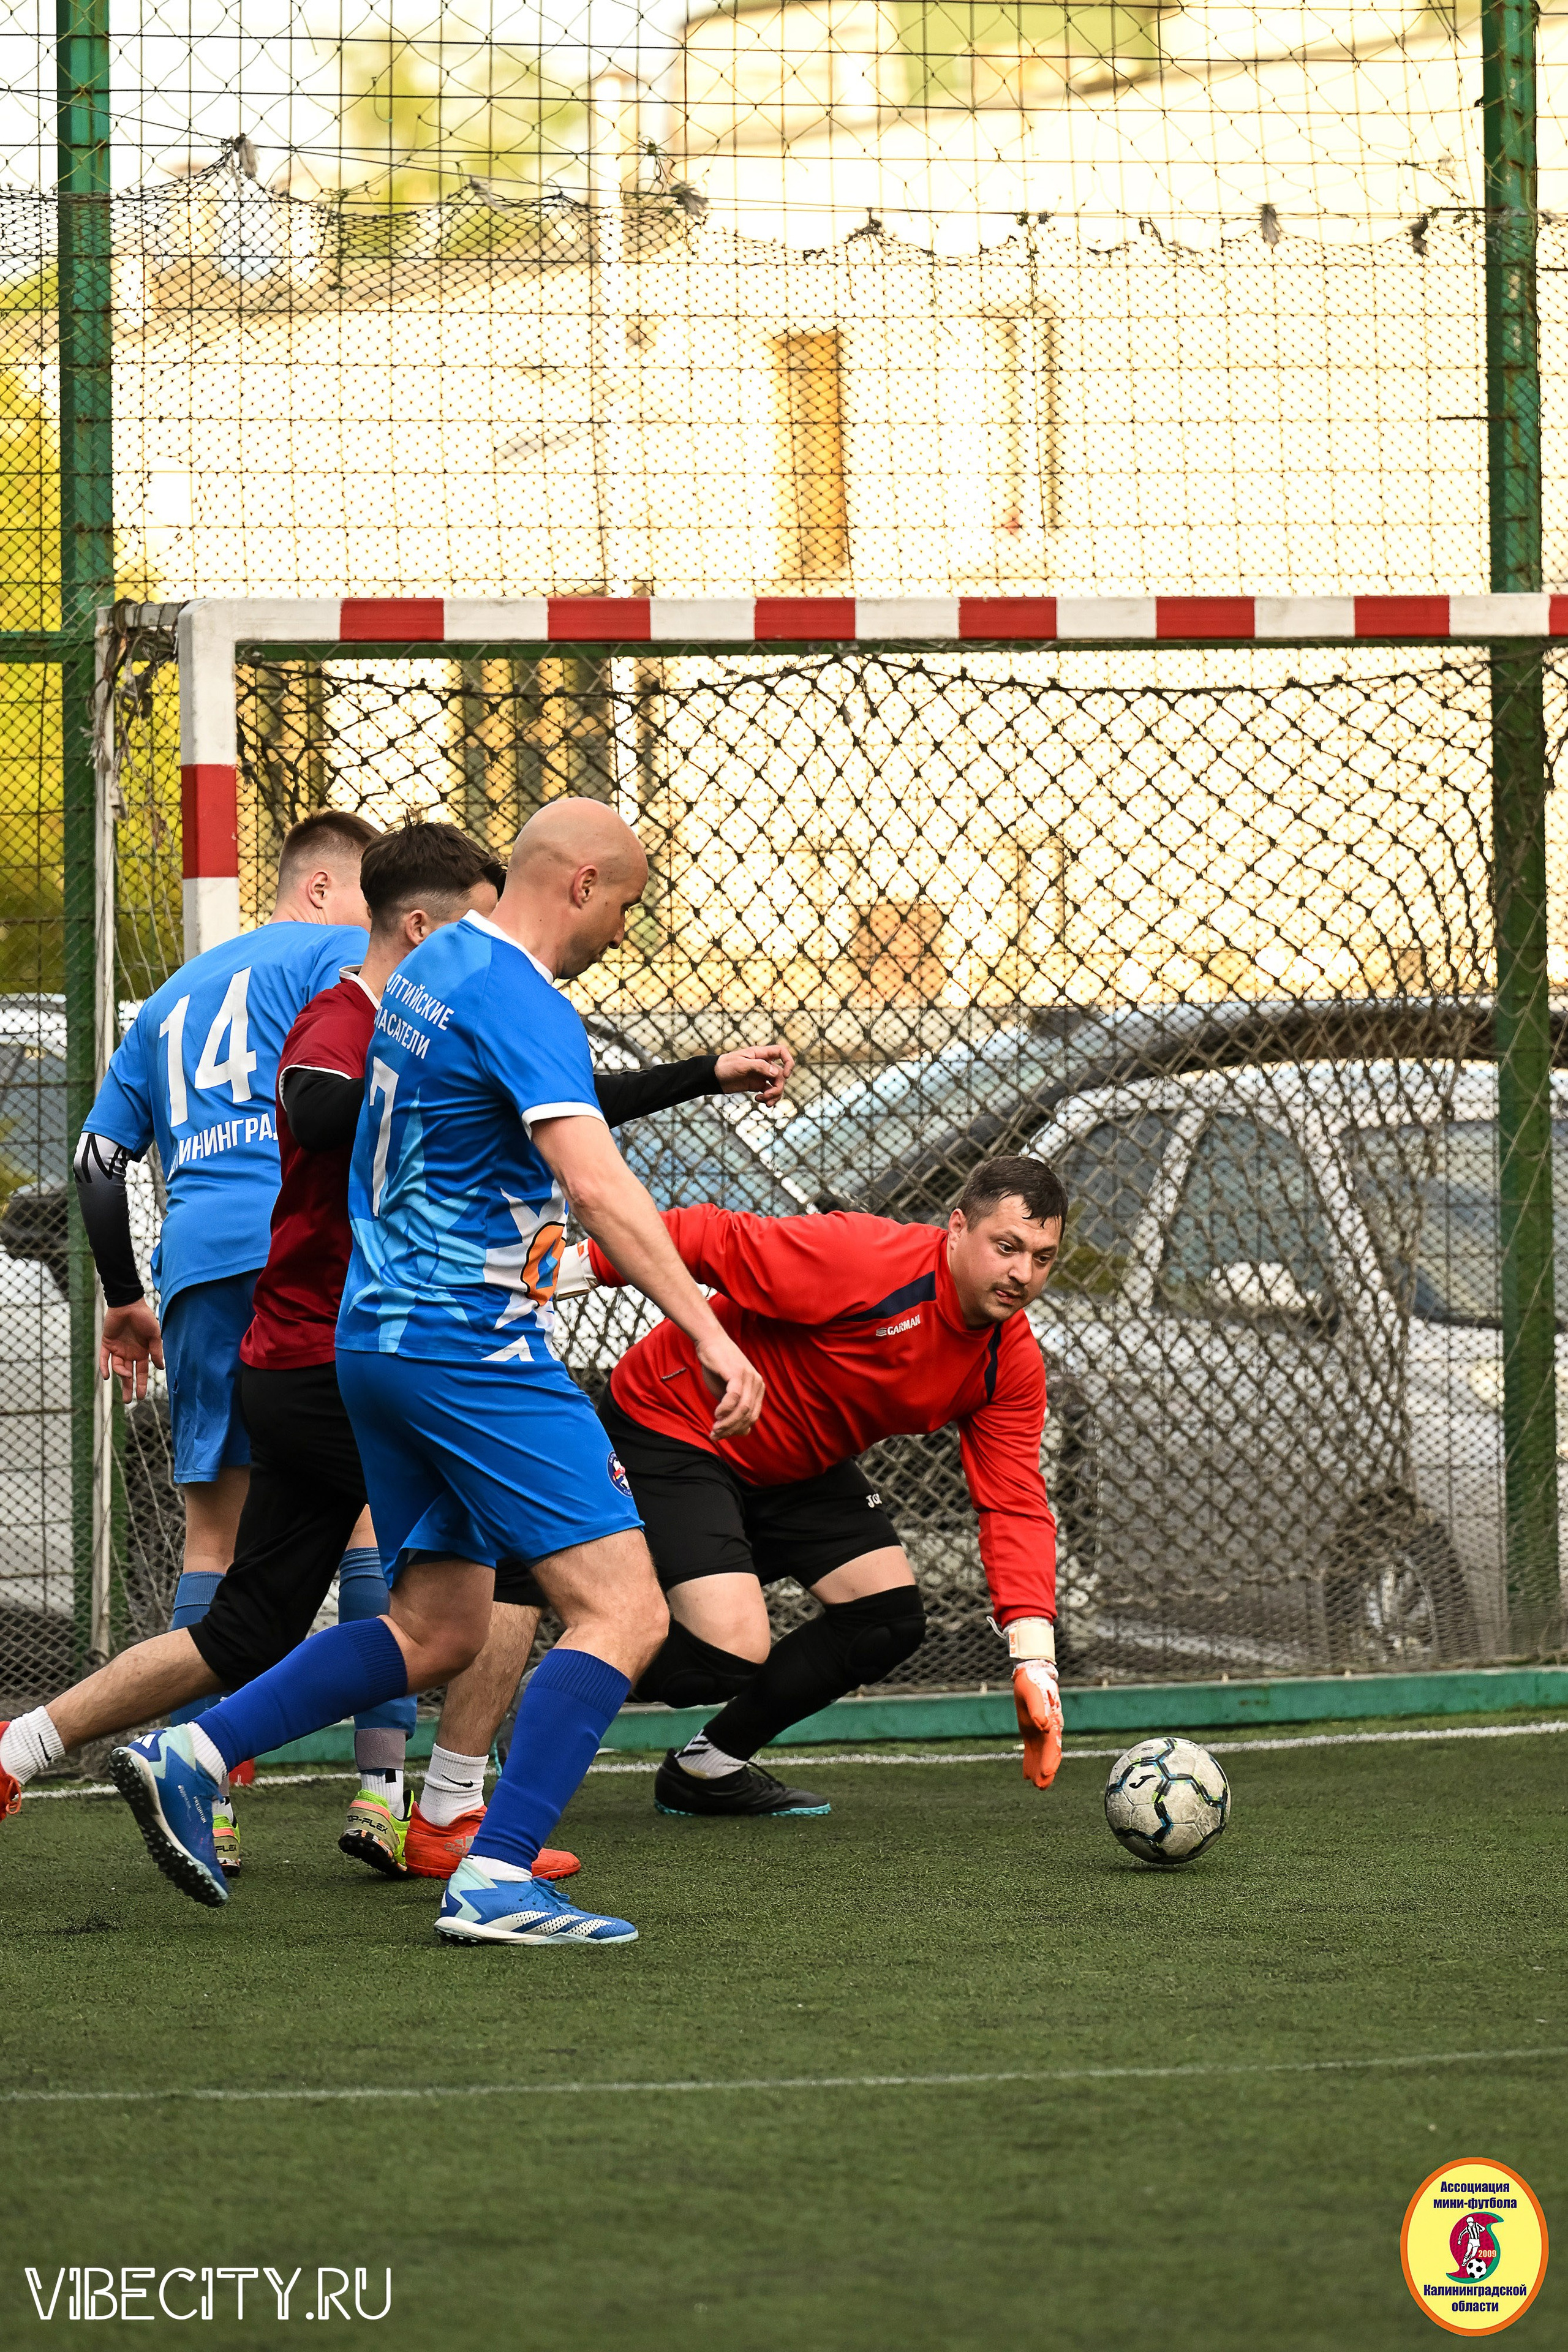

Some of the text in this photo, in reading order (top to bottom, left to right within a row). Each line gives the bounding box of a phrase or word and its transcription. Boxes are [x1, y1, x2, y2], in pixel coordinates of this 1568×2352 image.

[159, 966, 257, 1127] 14
[374, 1005, 431, 1060] ПАСАТЕЛИ
[369, 1056, 399, 1216] 7
[347, 1815, 388, 1834] OP-FLEX
